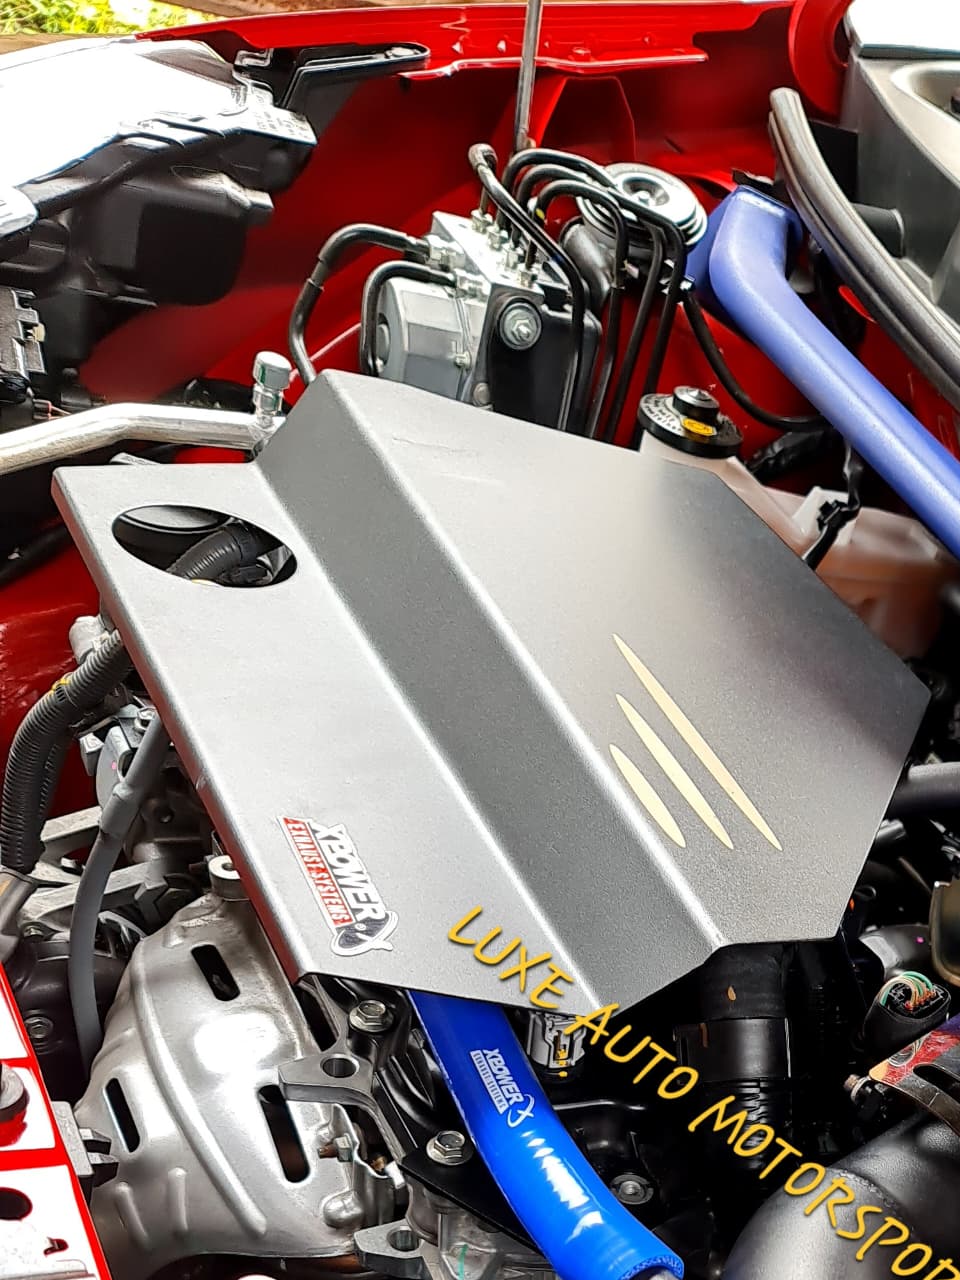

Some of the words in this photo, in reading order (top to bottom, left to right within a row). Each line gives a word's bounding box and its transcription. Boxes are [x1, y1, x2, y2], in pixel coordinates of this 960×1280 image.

[287, 822, 327, 870] EXHAUST
[309, 869, 351, 921] SYSTEMS
[310, 823, 386, 922] XPOWER
[482, 1048, 524, 1105] XPOWER
